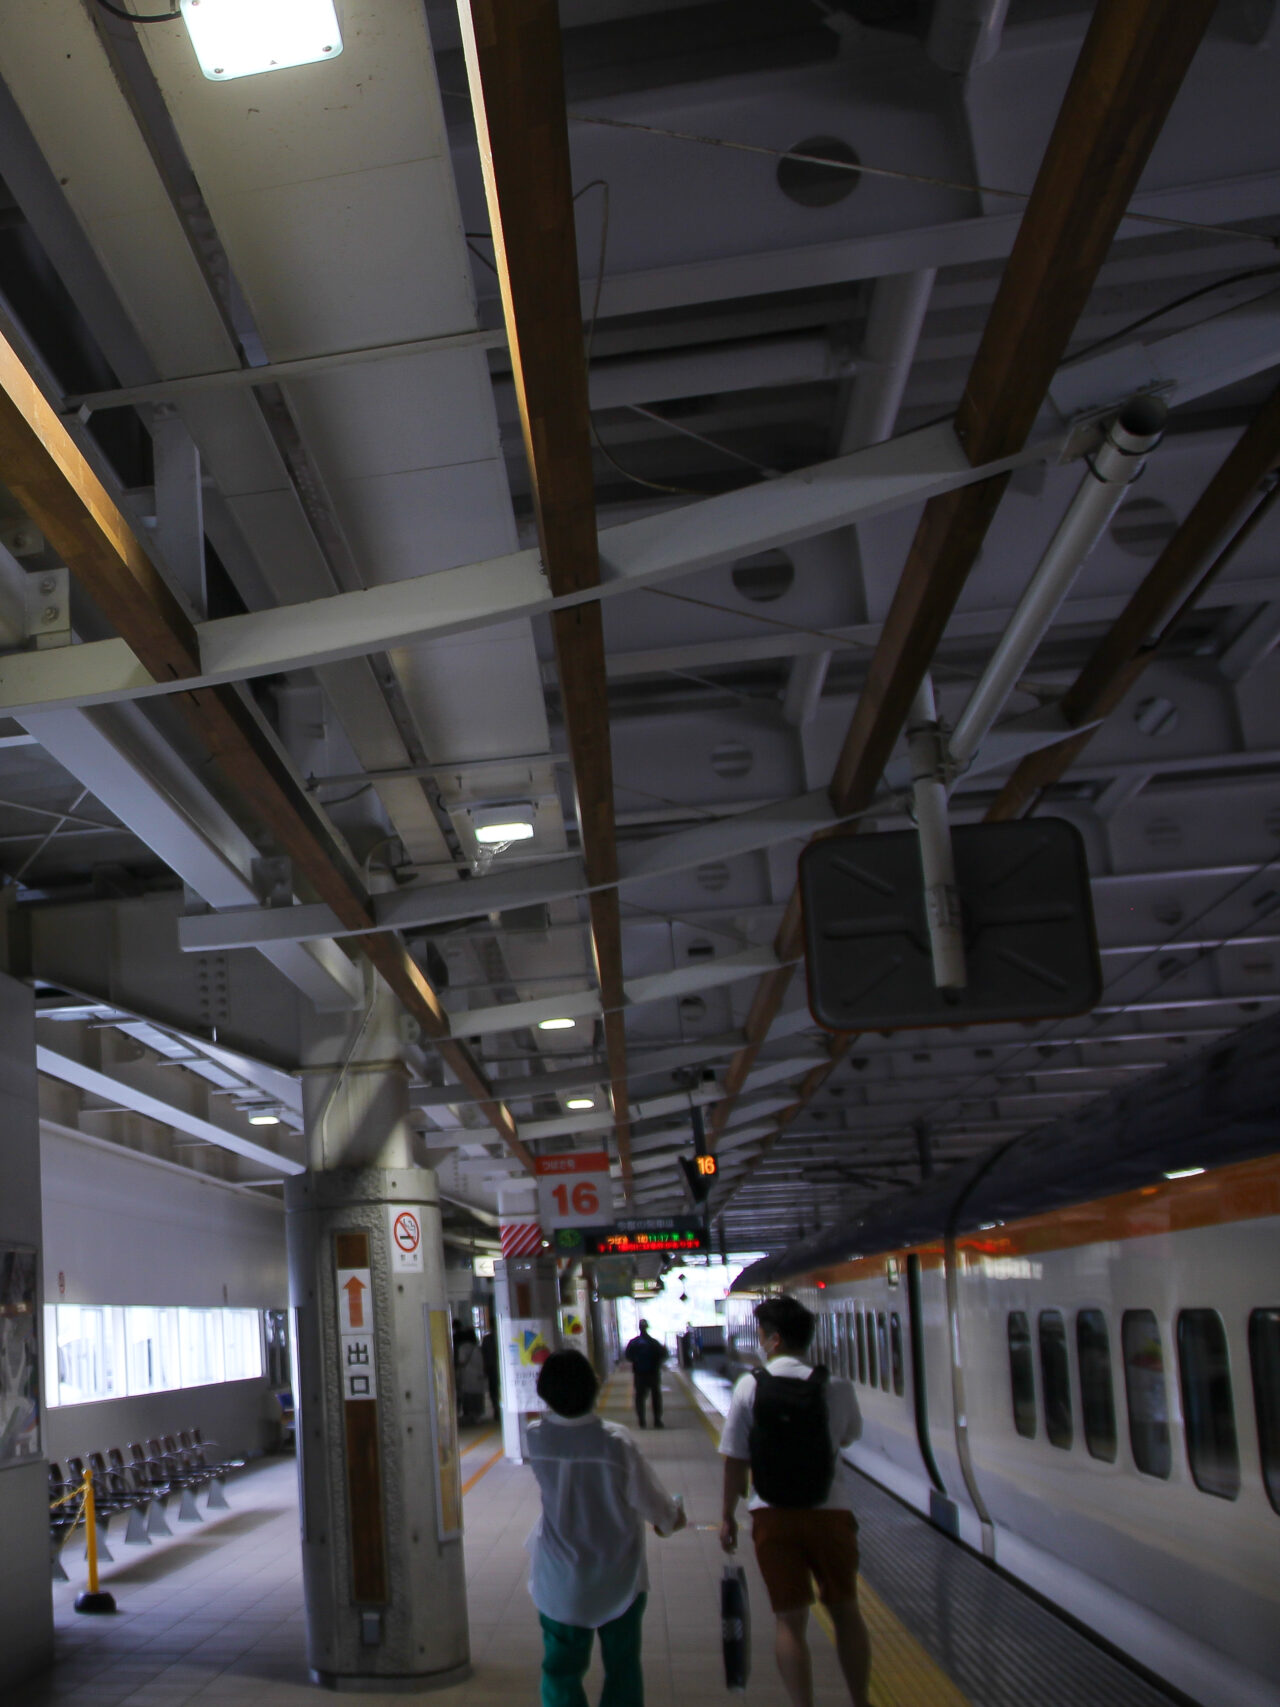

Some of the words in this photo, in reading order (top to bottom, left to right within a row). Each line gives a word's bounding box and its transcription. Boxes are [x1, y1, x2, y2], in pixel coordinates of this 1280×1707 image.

[697, 1155, 716, 1175] 16
[552, 1182, 599, 1216] 16
[348, 1342, 370, 1396] 出口
